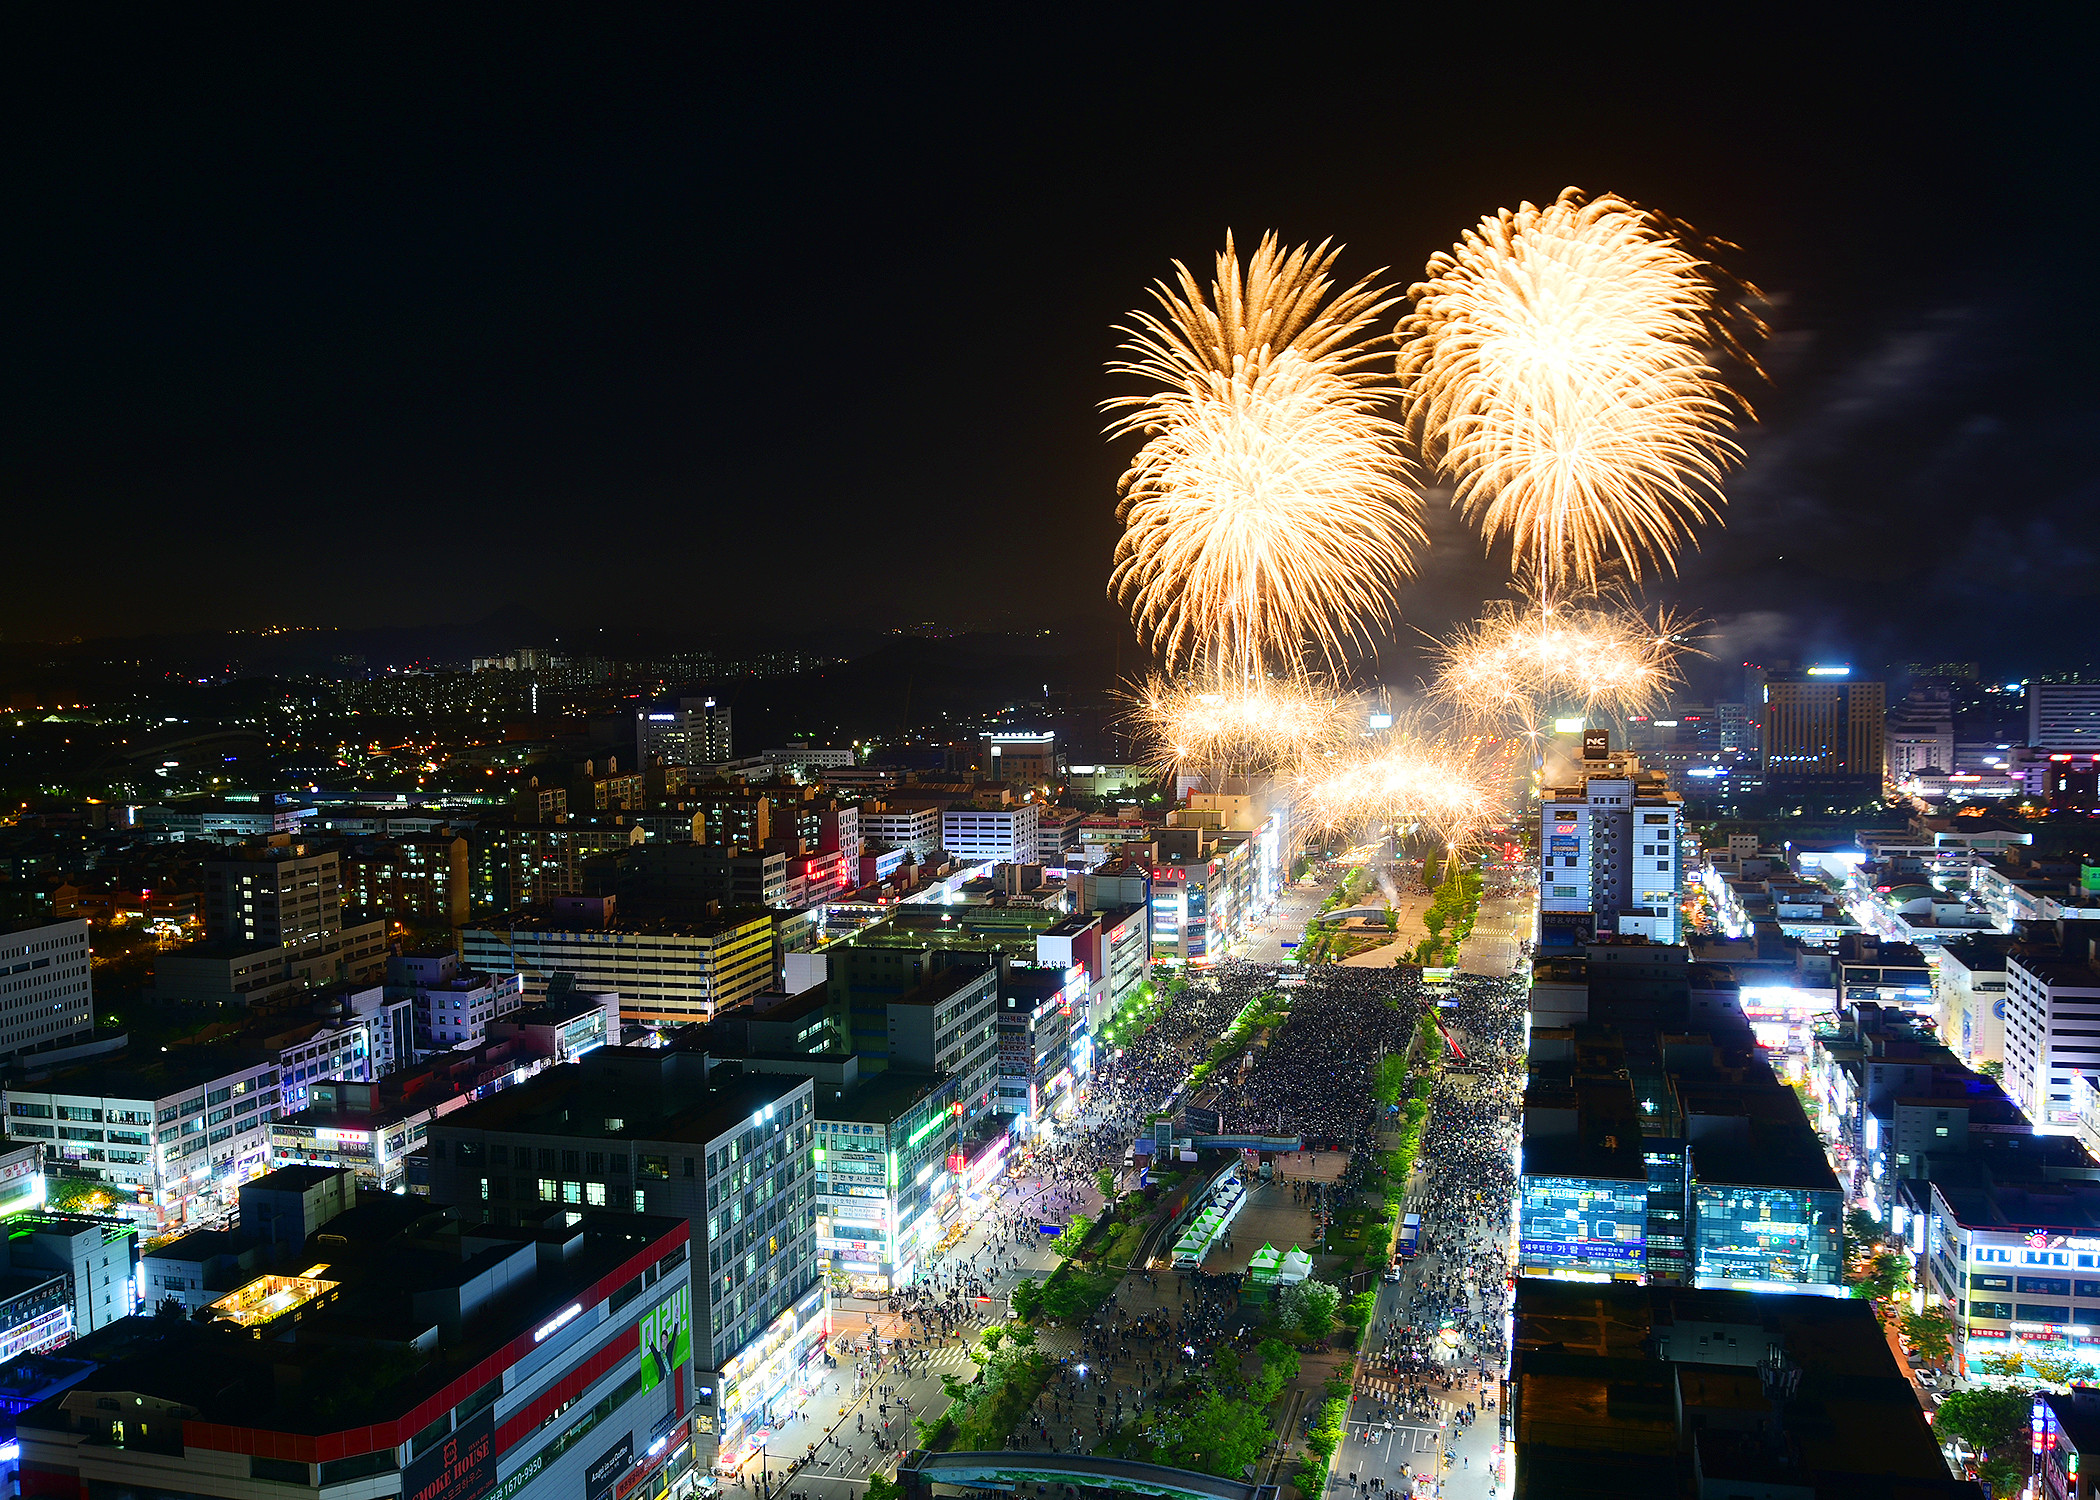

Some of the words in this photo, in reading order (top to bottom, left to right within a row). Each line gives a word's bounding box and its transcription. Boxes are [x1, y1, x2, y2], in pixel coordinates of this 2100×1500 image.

[1586, 737, 1606, 746] NC
[1628, 1249, 1641, 1258] 4F
[453, 1440, 490, 1479] HOUSE
[504, 1456, 542, 1496] 1670-9950
